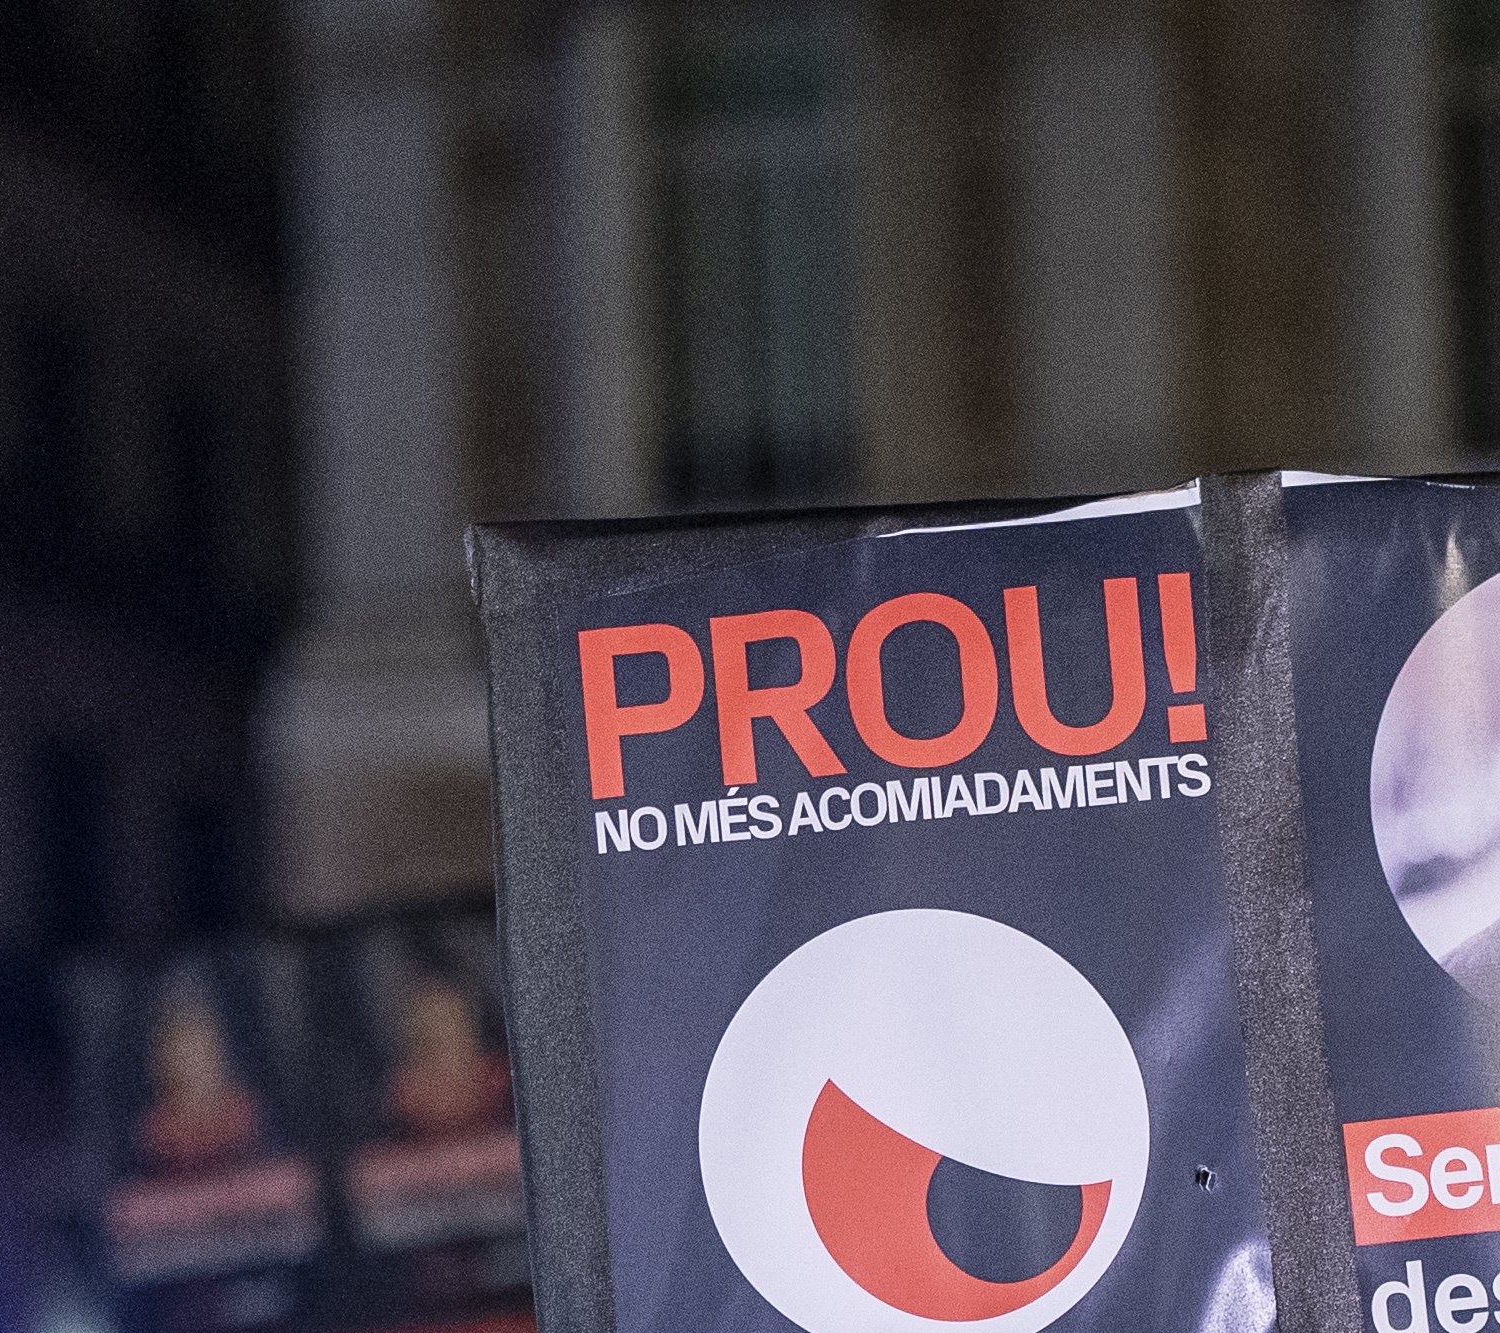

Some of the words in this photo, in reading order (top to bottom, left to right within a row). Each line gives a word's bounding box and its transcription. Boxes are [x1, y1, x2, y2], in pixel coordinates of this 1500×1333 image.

[578, 572, 1208, 800] PROU!
[595, 808, 668, 854] NO
[676, 786, 781, 848] MÉS
[788, 753, 1211, 837] ACOMIADAMENTS
